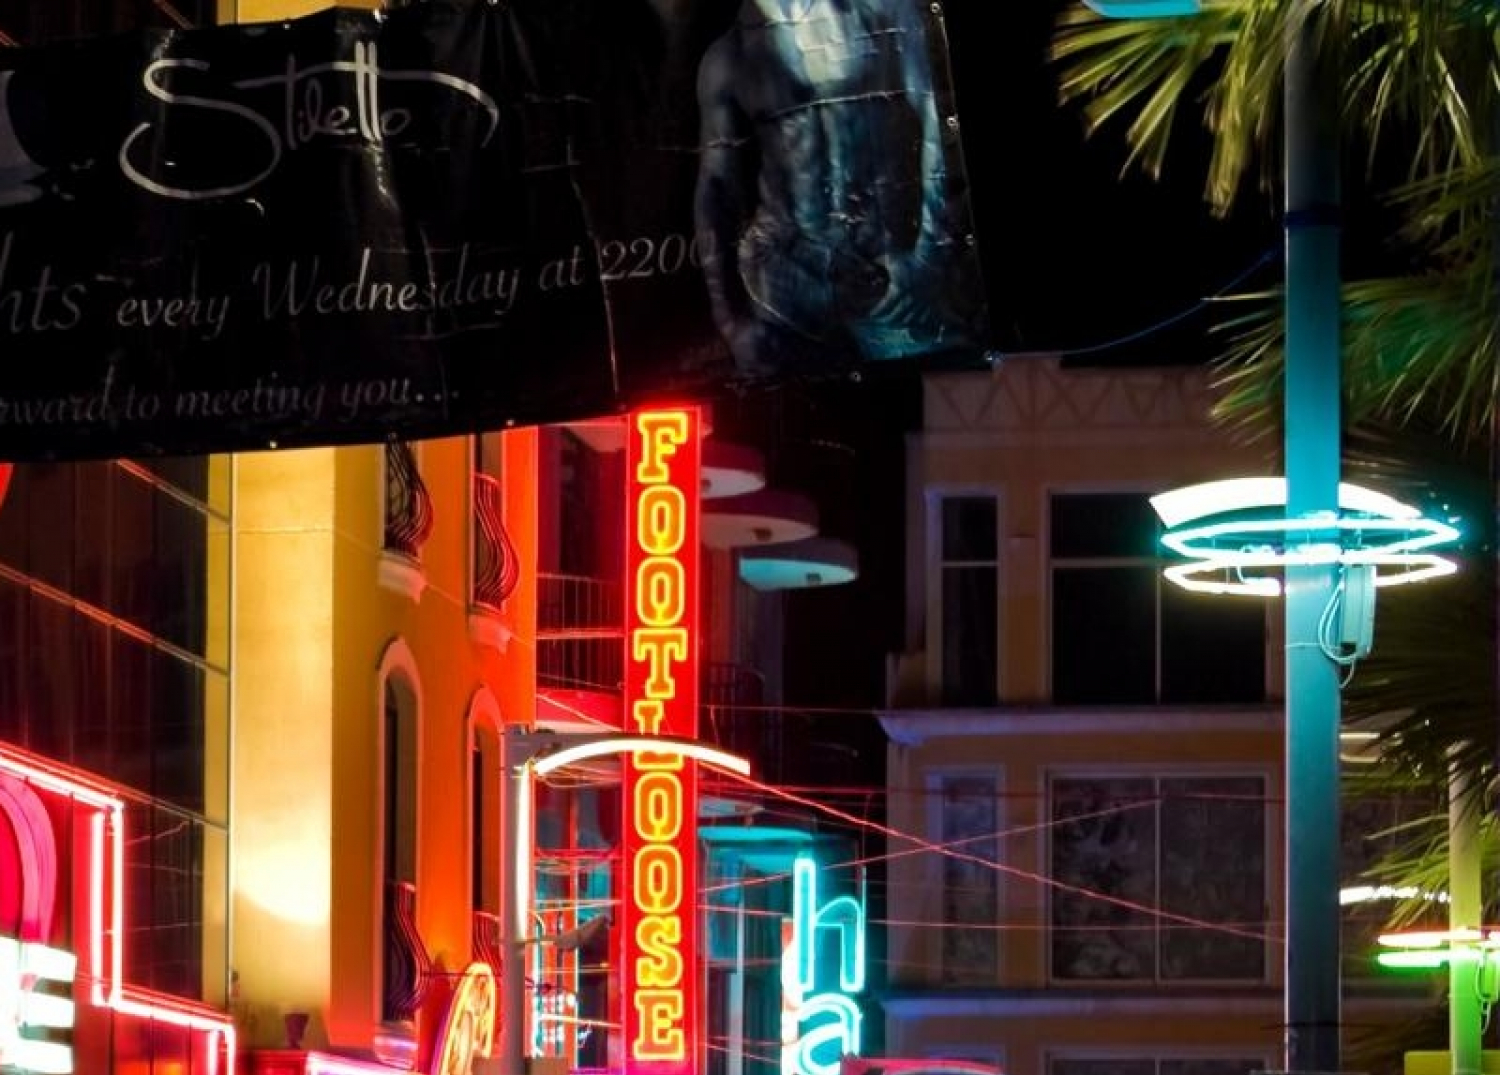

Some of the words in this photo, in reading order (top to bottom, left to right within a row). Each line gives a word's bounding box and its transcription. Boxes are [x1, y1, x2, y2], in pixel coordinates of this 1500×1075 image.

[118, 40, 500, 199] Stiletto
[116, 291, 231, 341] every
[251, 245, 521, 317] Wednesday
[539, 243, 586, 292] at
[124, 380, 161, 420] to
[175, 374, 326, 421] meeting
[632, 413, 688, 1062] FOOTLOOSE
